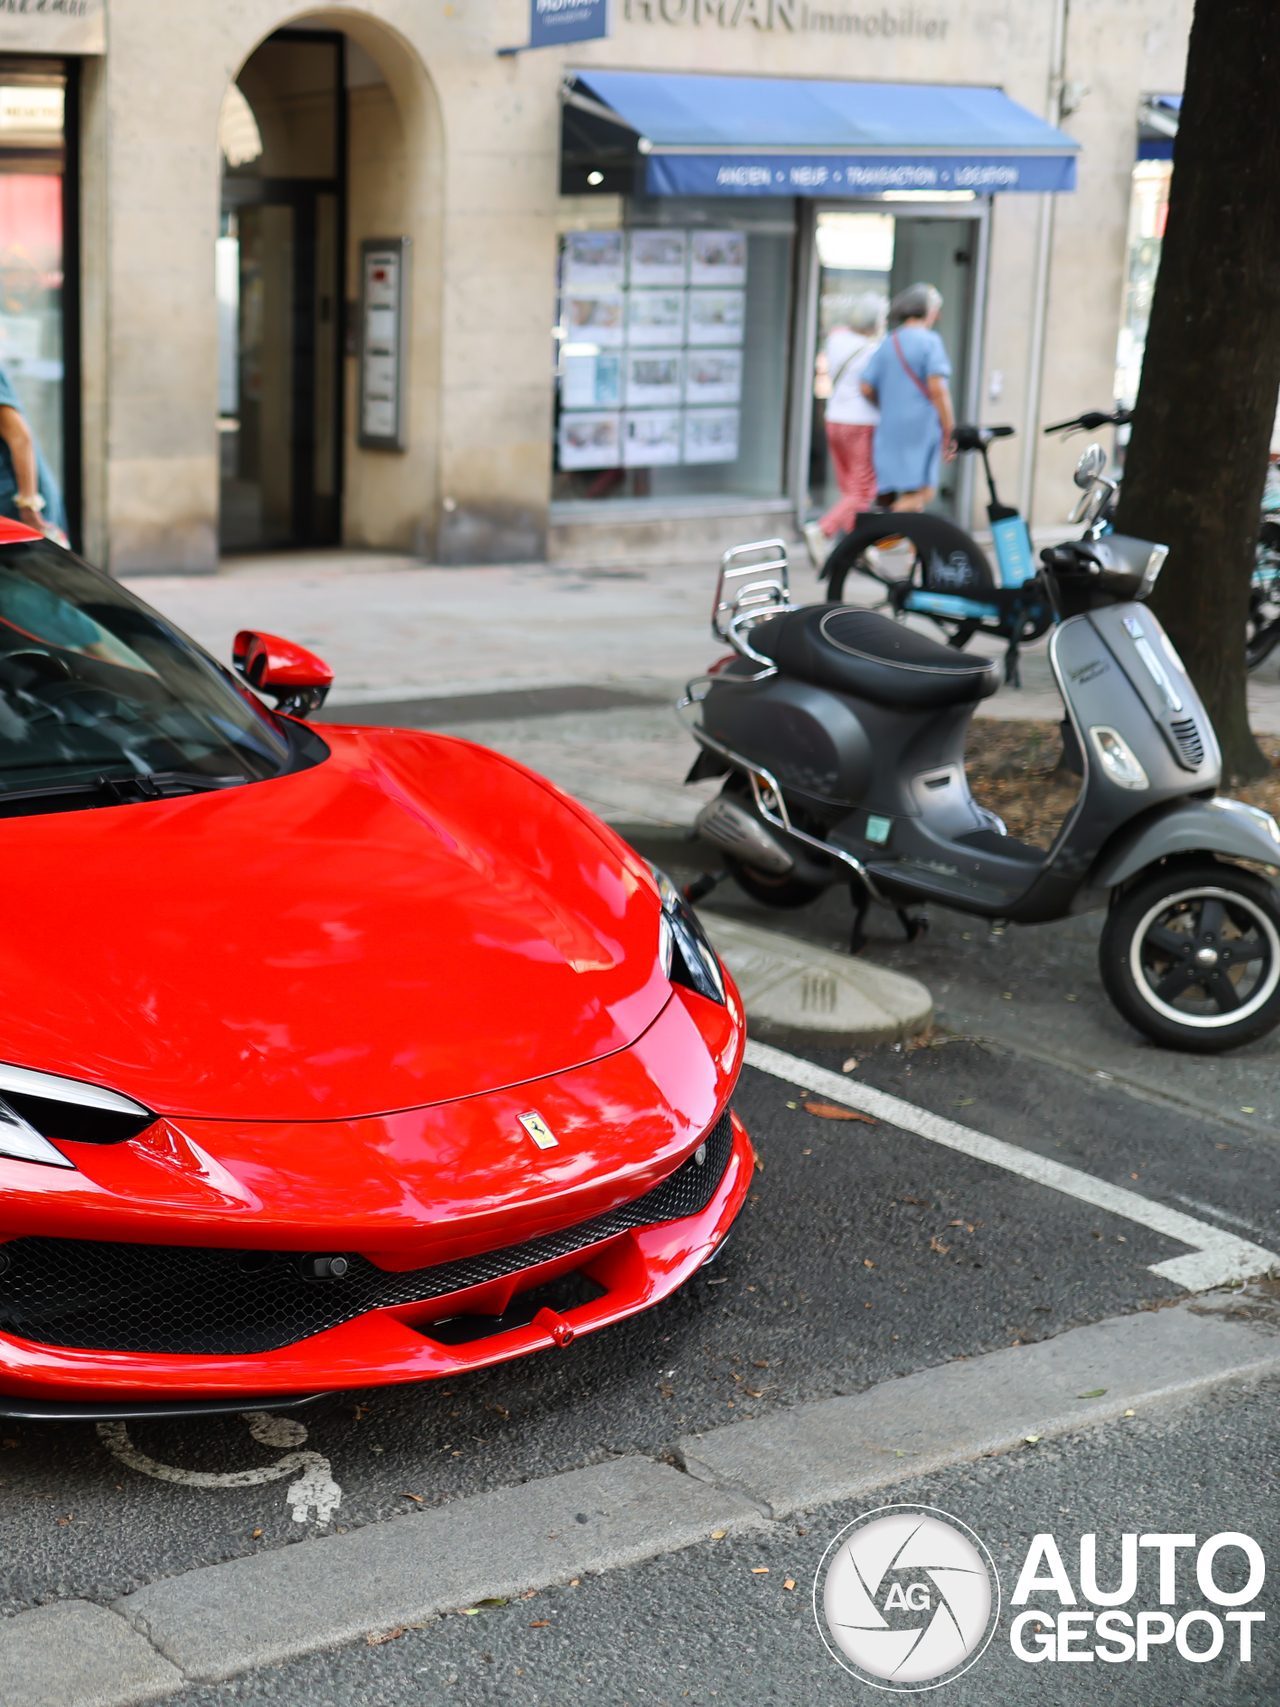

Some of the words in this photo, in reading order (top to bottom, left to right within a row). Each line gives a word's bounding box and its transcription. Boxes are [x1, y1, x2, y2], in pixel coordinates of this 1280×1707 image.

[801, 7, 950, 40] Immobilier
[716, 166, 771, 186] ANCIEN
[790, 166, 829, 186] NEUF
[846, 166, 938, 186] TRANSACTION
[954, 166, 1019, 186] LOCATION
